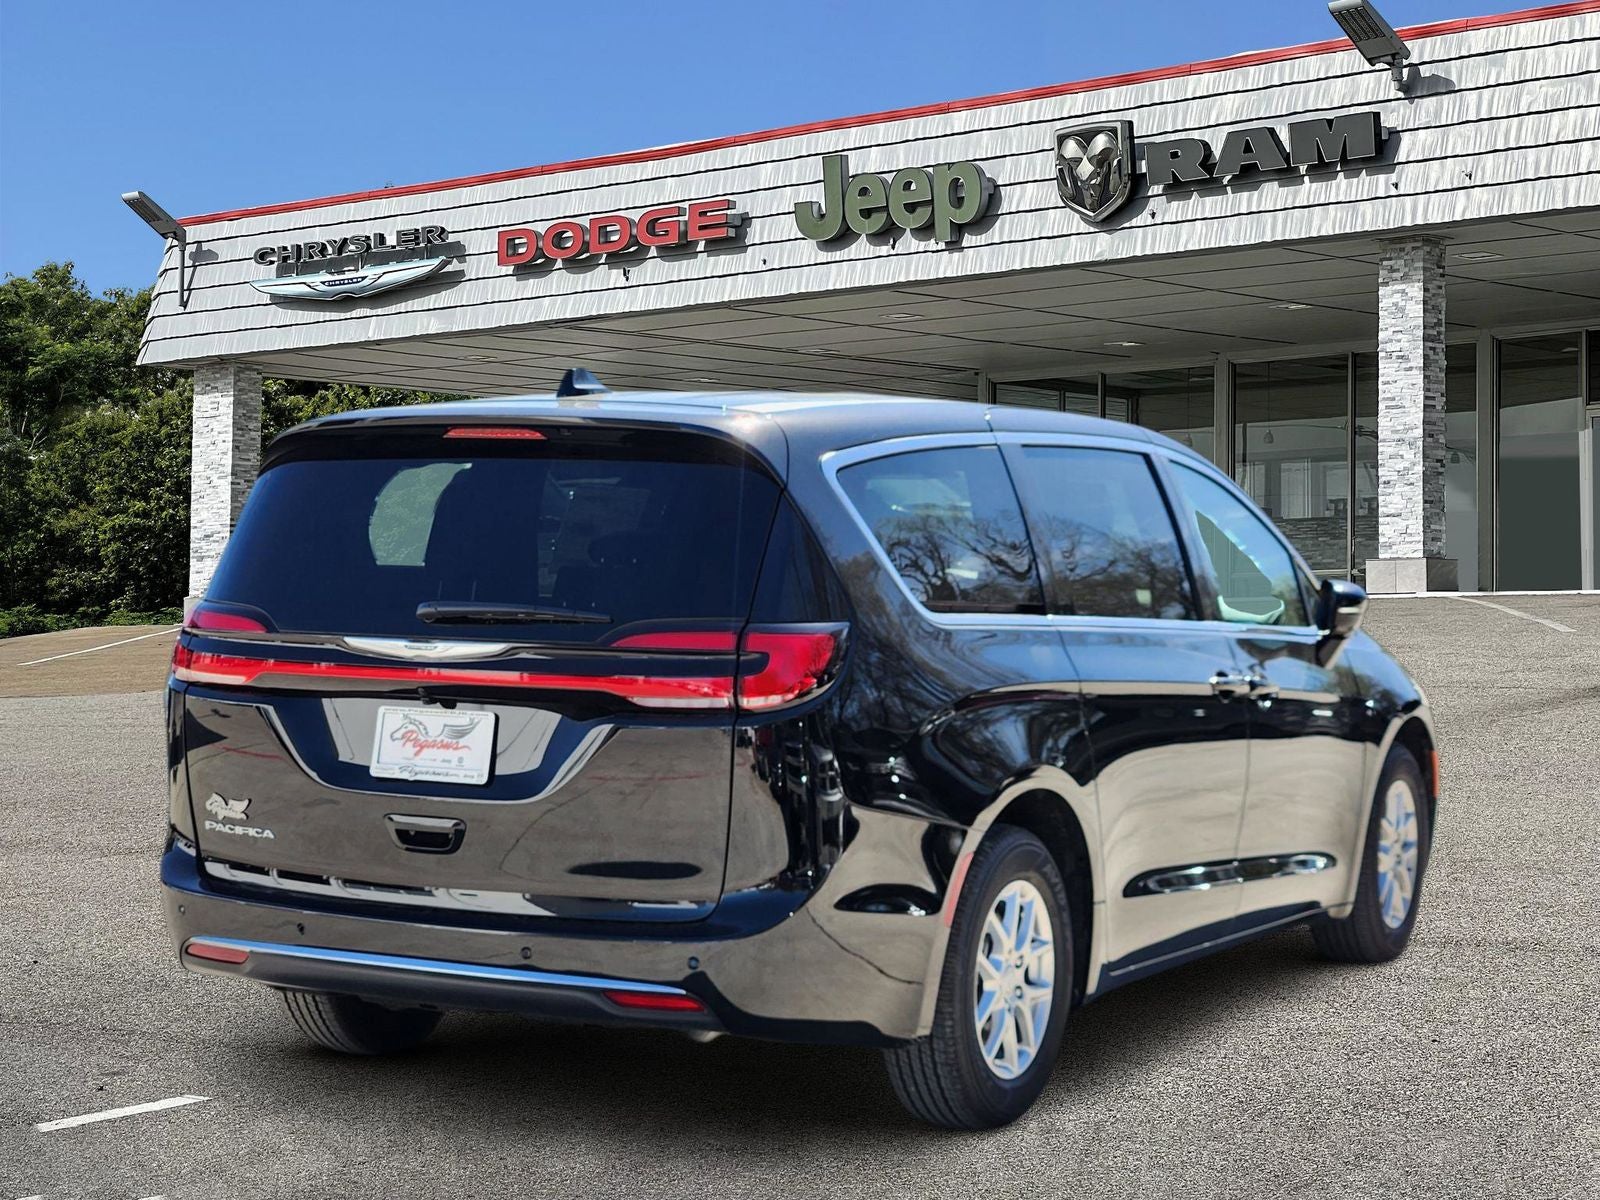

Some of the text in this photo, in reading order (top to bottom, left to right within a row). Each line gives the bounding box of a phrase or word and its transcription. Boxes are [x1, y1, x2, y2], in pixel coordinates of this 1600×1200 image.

[1145, 112, 1379, 186] RAM
[794, 154, 984, 242] Jeep
[253, 225, 448, 266] CHRYSLER
[497, 199, 733, 267] DODGE
[324, 276, 363, 287] CHRYSLER
[401, 730, 472, 757] Pegasus
[204, 820, 275, 839] PACIFICA
